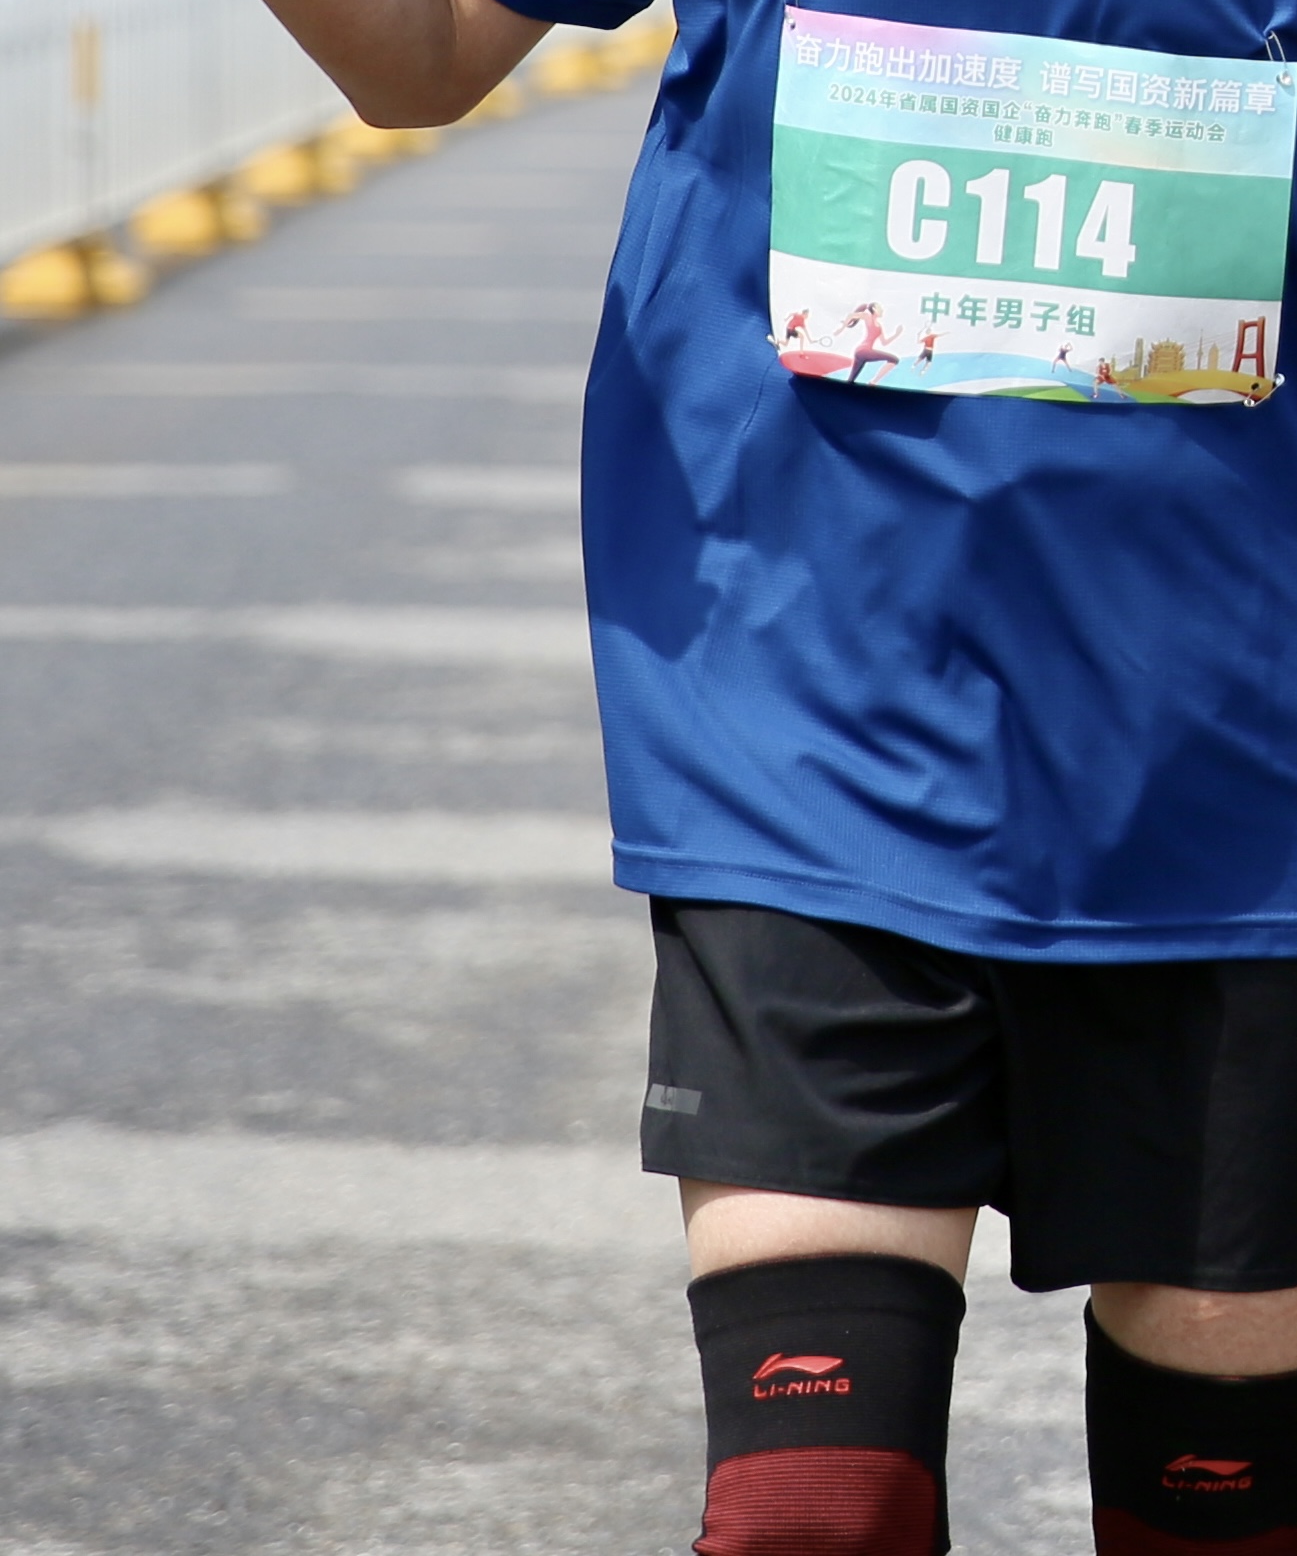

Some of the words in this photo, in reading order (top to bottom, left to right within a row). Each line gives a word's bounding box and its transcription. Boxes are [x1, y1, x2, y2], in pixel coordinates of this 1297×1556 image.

[796, 34, 1022, 90] 奋力跑出加速度
[1040, 61, 1276, 114] 谱写国资新篇章
[993, 125, 1054, 148] 健康跑
[886, 159, 1137, 279] C114
[919, 291, 1096, 338] 中年男子组
[753, 1377, 851, 1399] LI-NING
[1162, 1474, 1252, 1491] LI-NING
